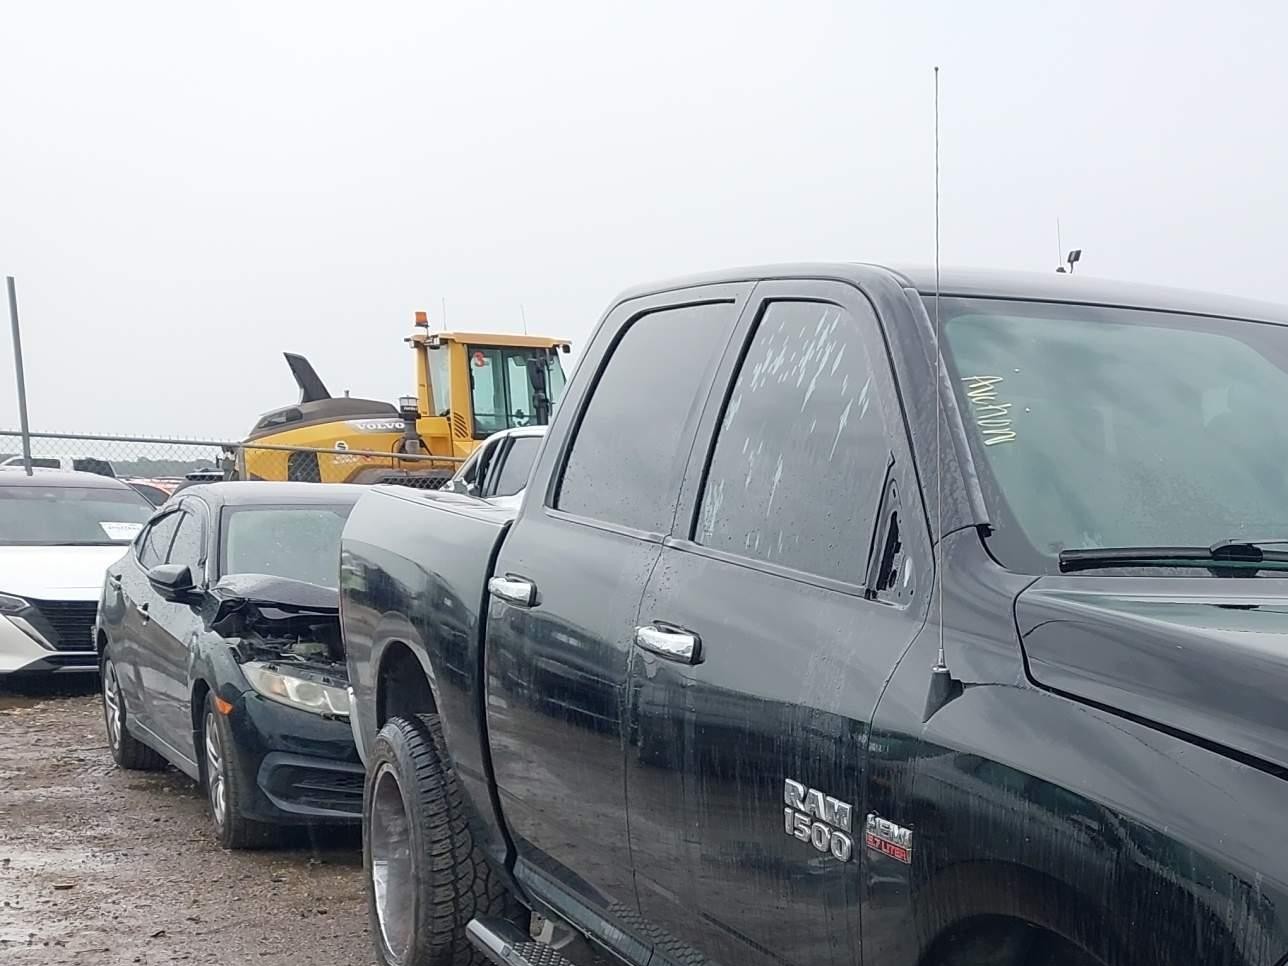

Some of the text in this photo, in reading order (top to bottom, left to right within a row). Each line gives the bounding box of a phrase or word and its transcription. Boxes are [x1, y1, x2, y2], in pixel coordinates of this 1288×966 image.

[357, 422, 405, 430] VOLVO
[784, 778, 852, 831] RAM
[784, 807, 851, 862] 1500
